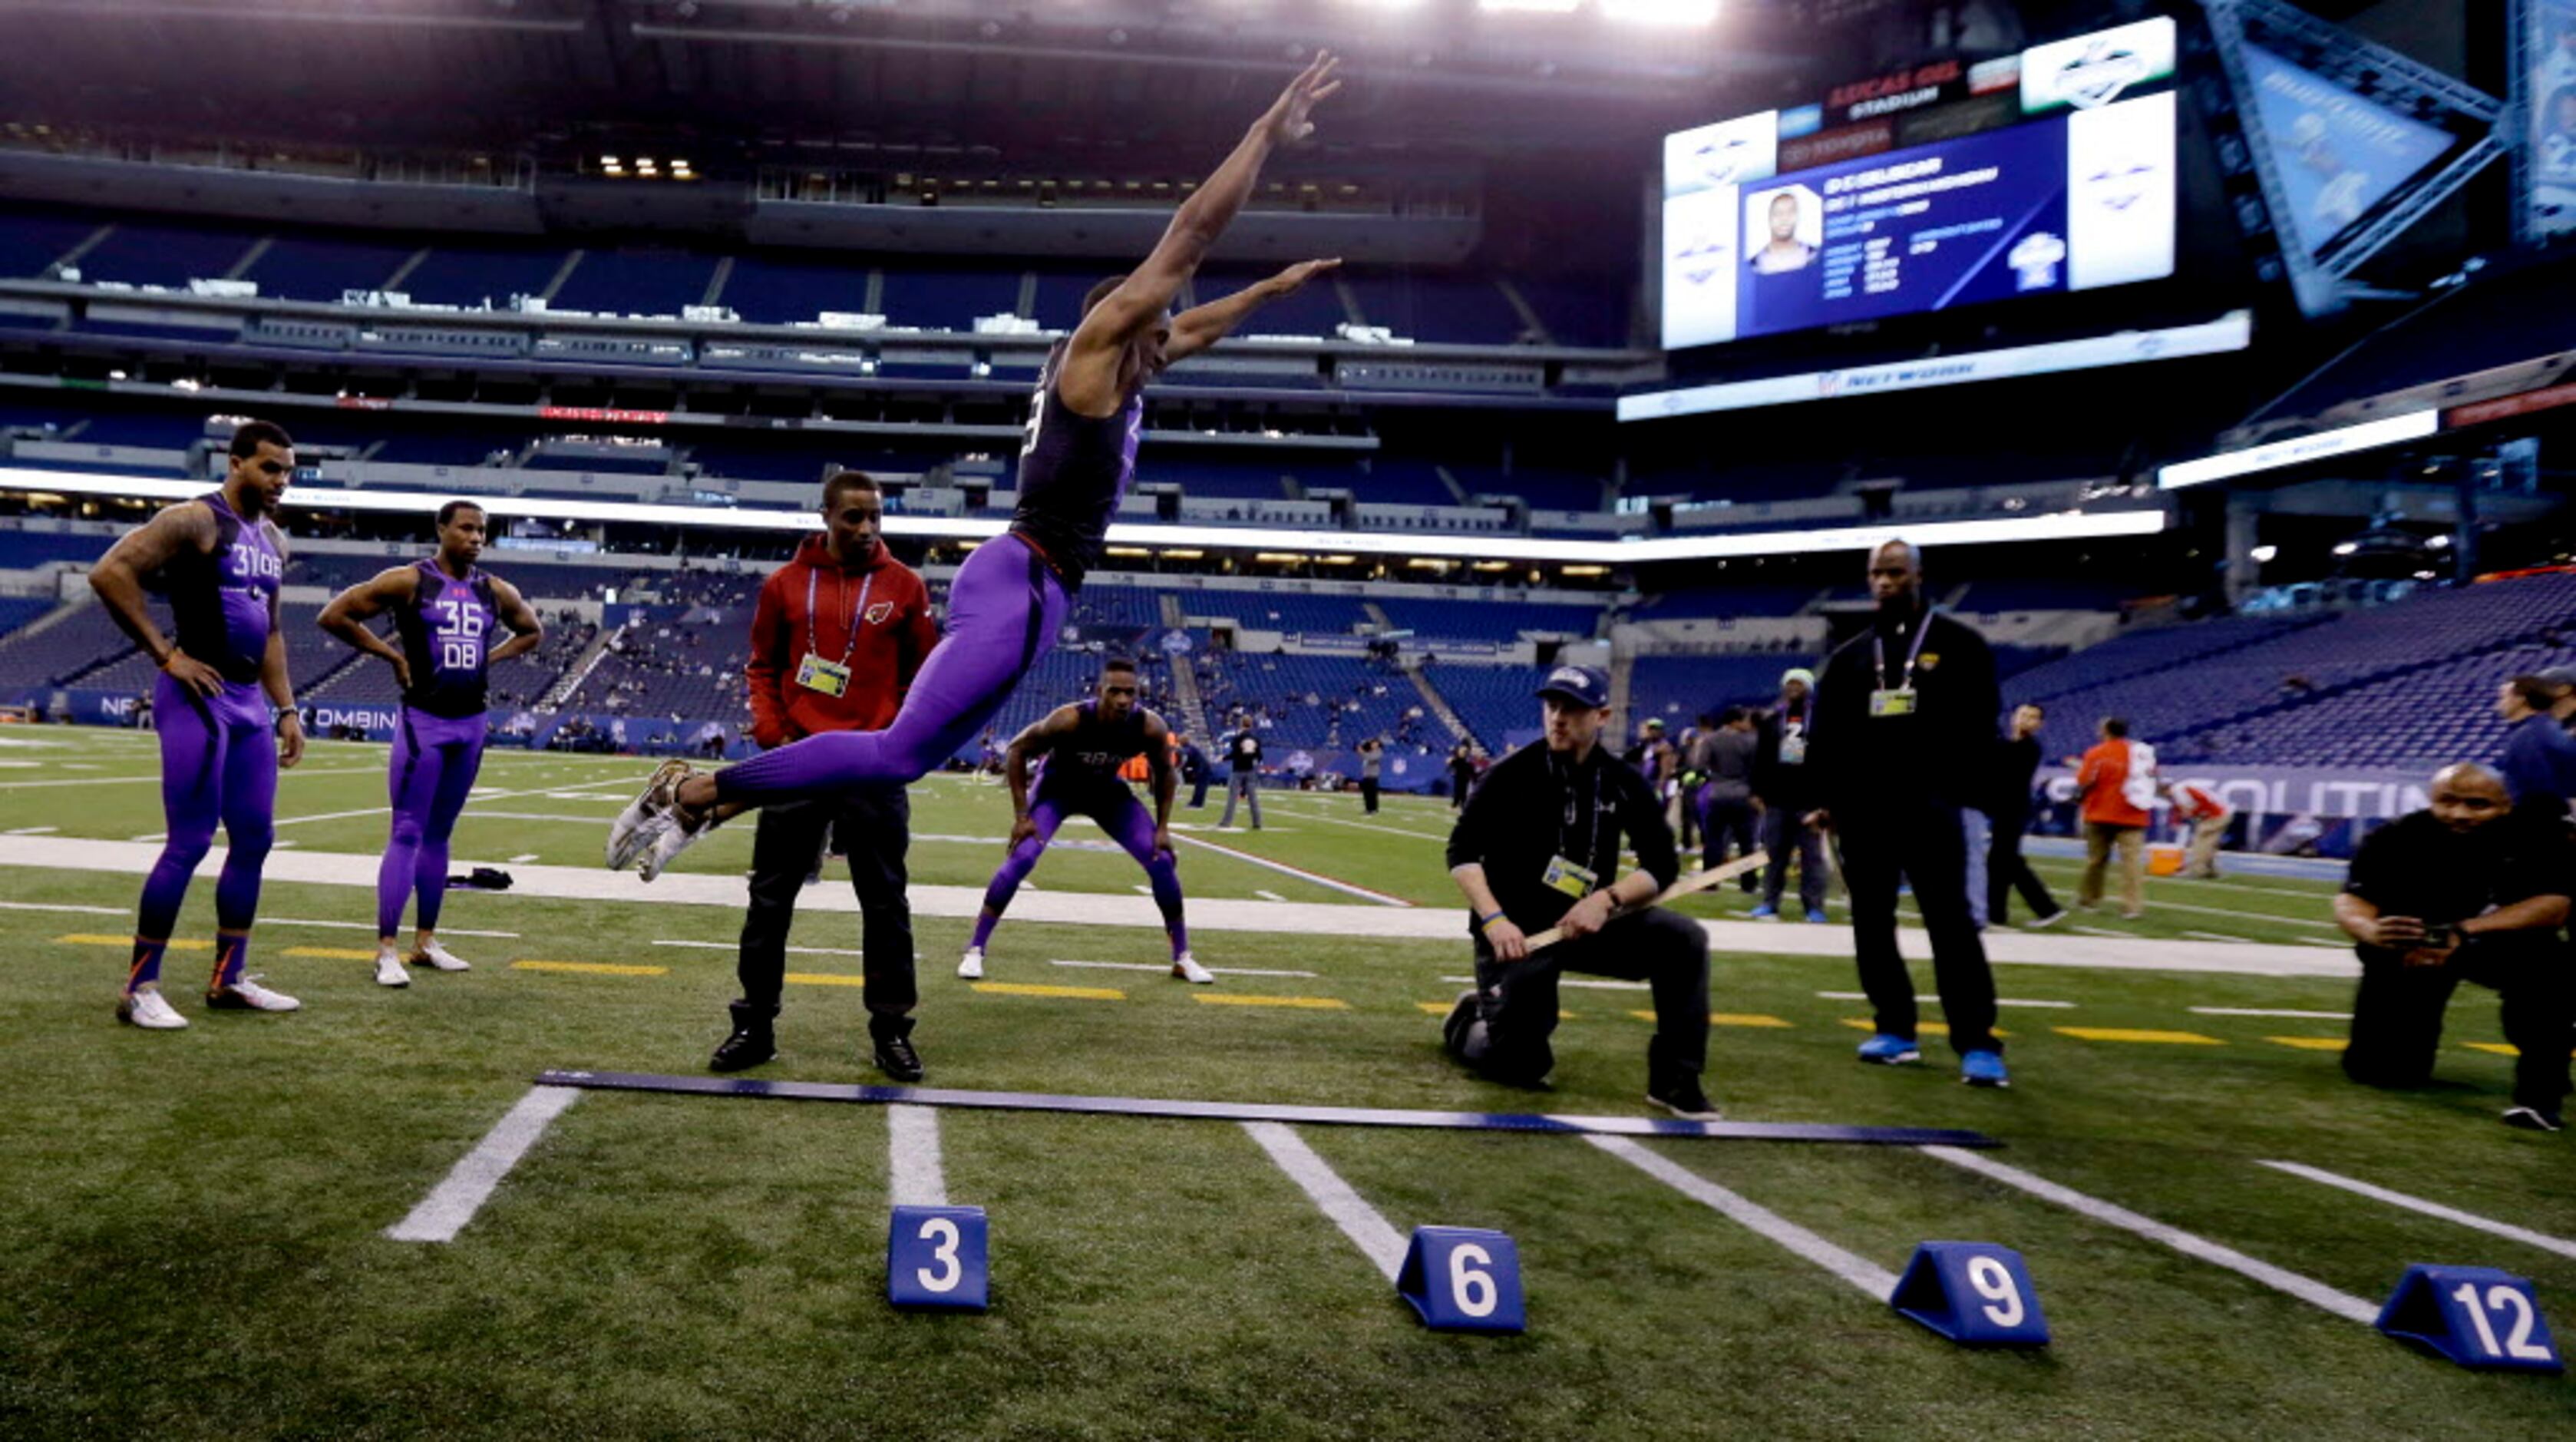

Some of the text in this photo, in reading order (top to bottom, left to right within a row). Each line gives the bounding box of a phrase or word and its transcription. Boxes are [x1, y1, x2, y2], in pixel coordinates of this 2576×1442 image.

[1848, 85, 1940, 121] STADIUM
[233, 543, 259, 577] 31
[435, 600, 484, 637] 36
[444, 643, 476, 669] DB
[102, 696, 135, 715] NF
[299, 707, 396, 729] COMBIN
[916, 1217, 963, 1292] 3
[1448, 1242, 1498, 1318] 6
[1967, 1255, 2026, 1328] 9
[2453, 1283, 2552, 1360] 12
